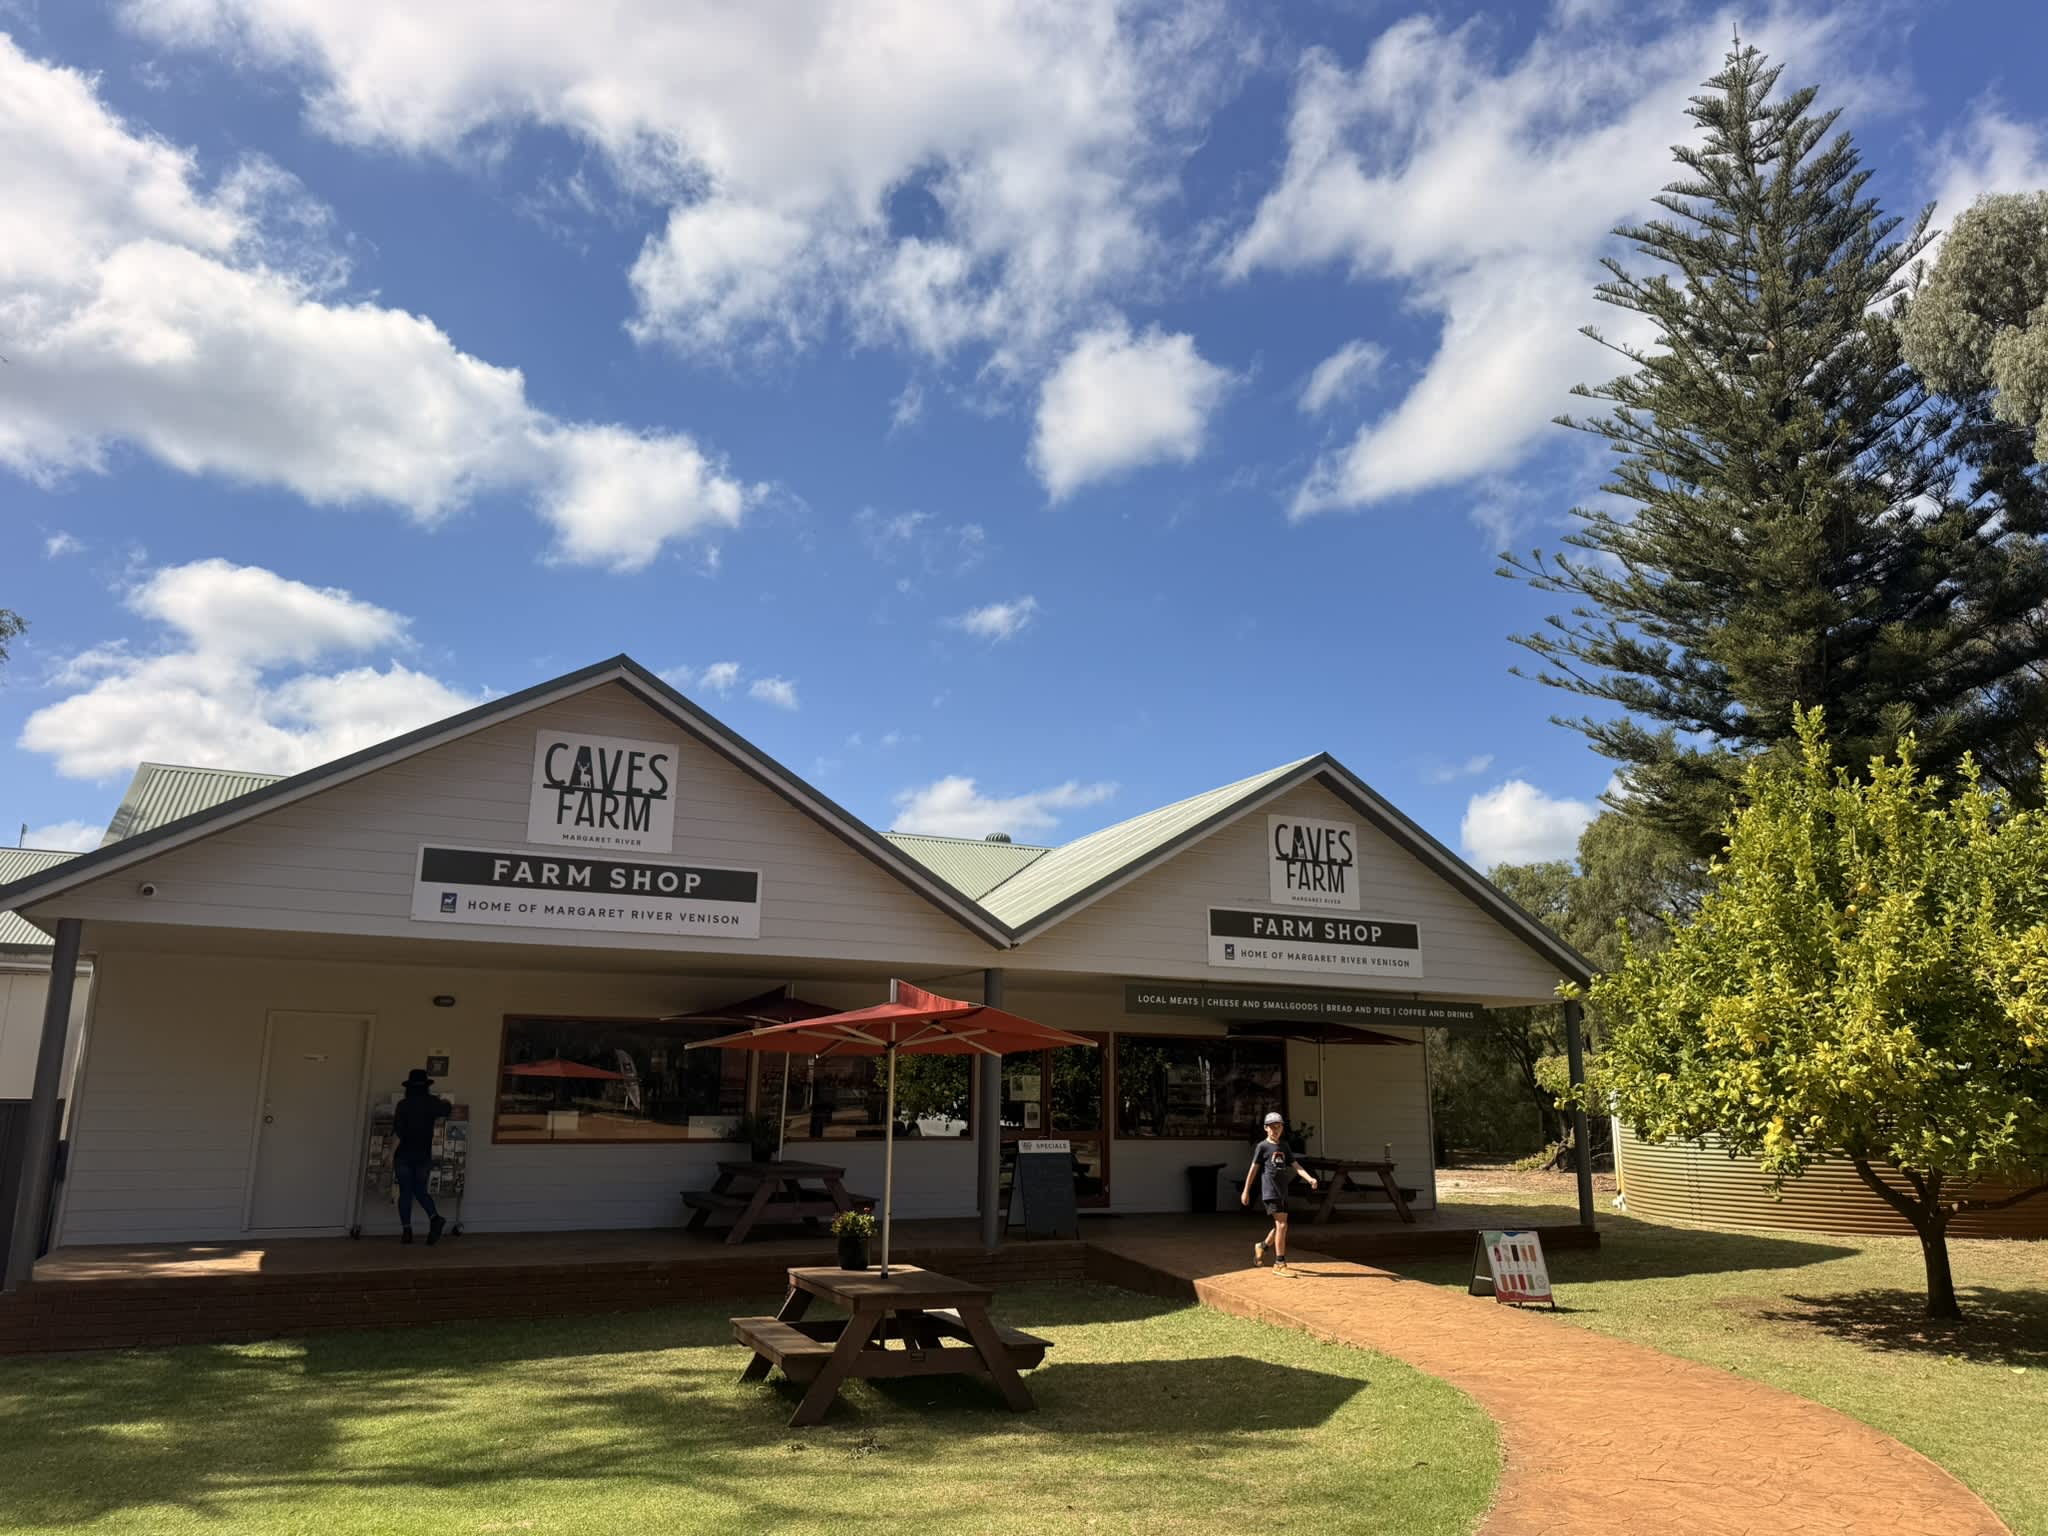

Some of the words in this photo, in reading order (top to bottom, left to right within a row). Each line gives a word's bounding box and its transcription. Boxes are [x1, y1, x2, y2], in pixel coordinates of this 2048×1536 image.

[544, 742, 668, 796] CAVES
[556, 789, 651, 832] FARM
[562, 834, 612, 845] MARGARET
[615, 837, 642, 846] RIVER
[1275, 823, 1353, 866] CAVES
[492, 859, 592, 888] FARM
[609, 867, 702, 894] SHOP
[1286, 861, 1345, 894] FARM
[468, 899, 511, 913] HOME
[518, 903, 537, 914] OF
[544, 904, 624, 919] MARGARET
[631, 909, 673, 922] RIVER
[679, 912, 740, 925] VENISON
[1253, 917, 1314, 938] FARM
[1324, 922, 1382, 943] SHOP
[1241, 949, 1268, 960] HOME
[1271, 951, 1284, 960] OF
[1287, 952, 1337, 964] MARGARET
[1340, 955, 1368, 965] RIVER
[1371, 957, 1410, 968] VENISON
[1138, 994, 1167, 1005] LOCAL
[1170, 996, 1199, 1007] MEATS
[1207, 998, 1239, 1008] CHEESE
[1243, 1000, 1260, 1009] AND
[1263, 1000, 1319, 1012] SMALLGOODS
[1326, 1003, 1353, 1014] BREAD
[1355, 1005, 1371, 1014] AND
[1374, 1006, 1391, 1015] PIES
[1399, 1007, 1427, 1017] COFFEE
[1429, 1009, 1444, 1018] AND
[1447, 1010, 1474, 1019] DRINKS
